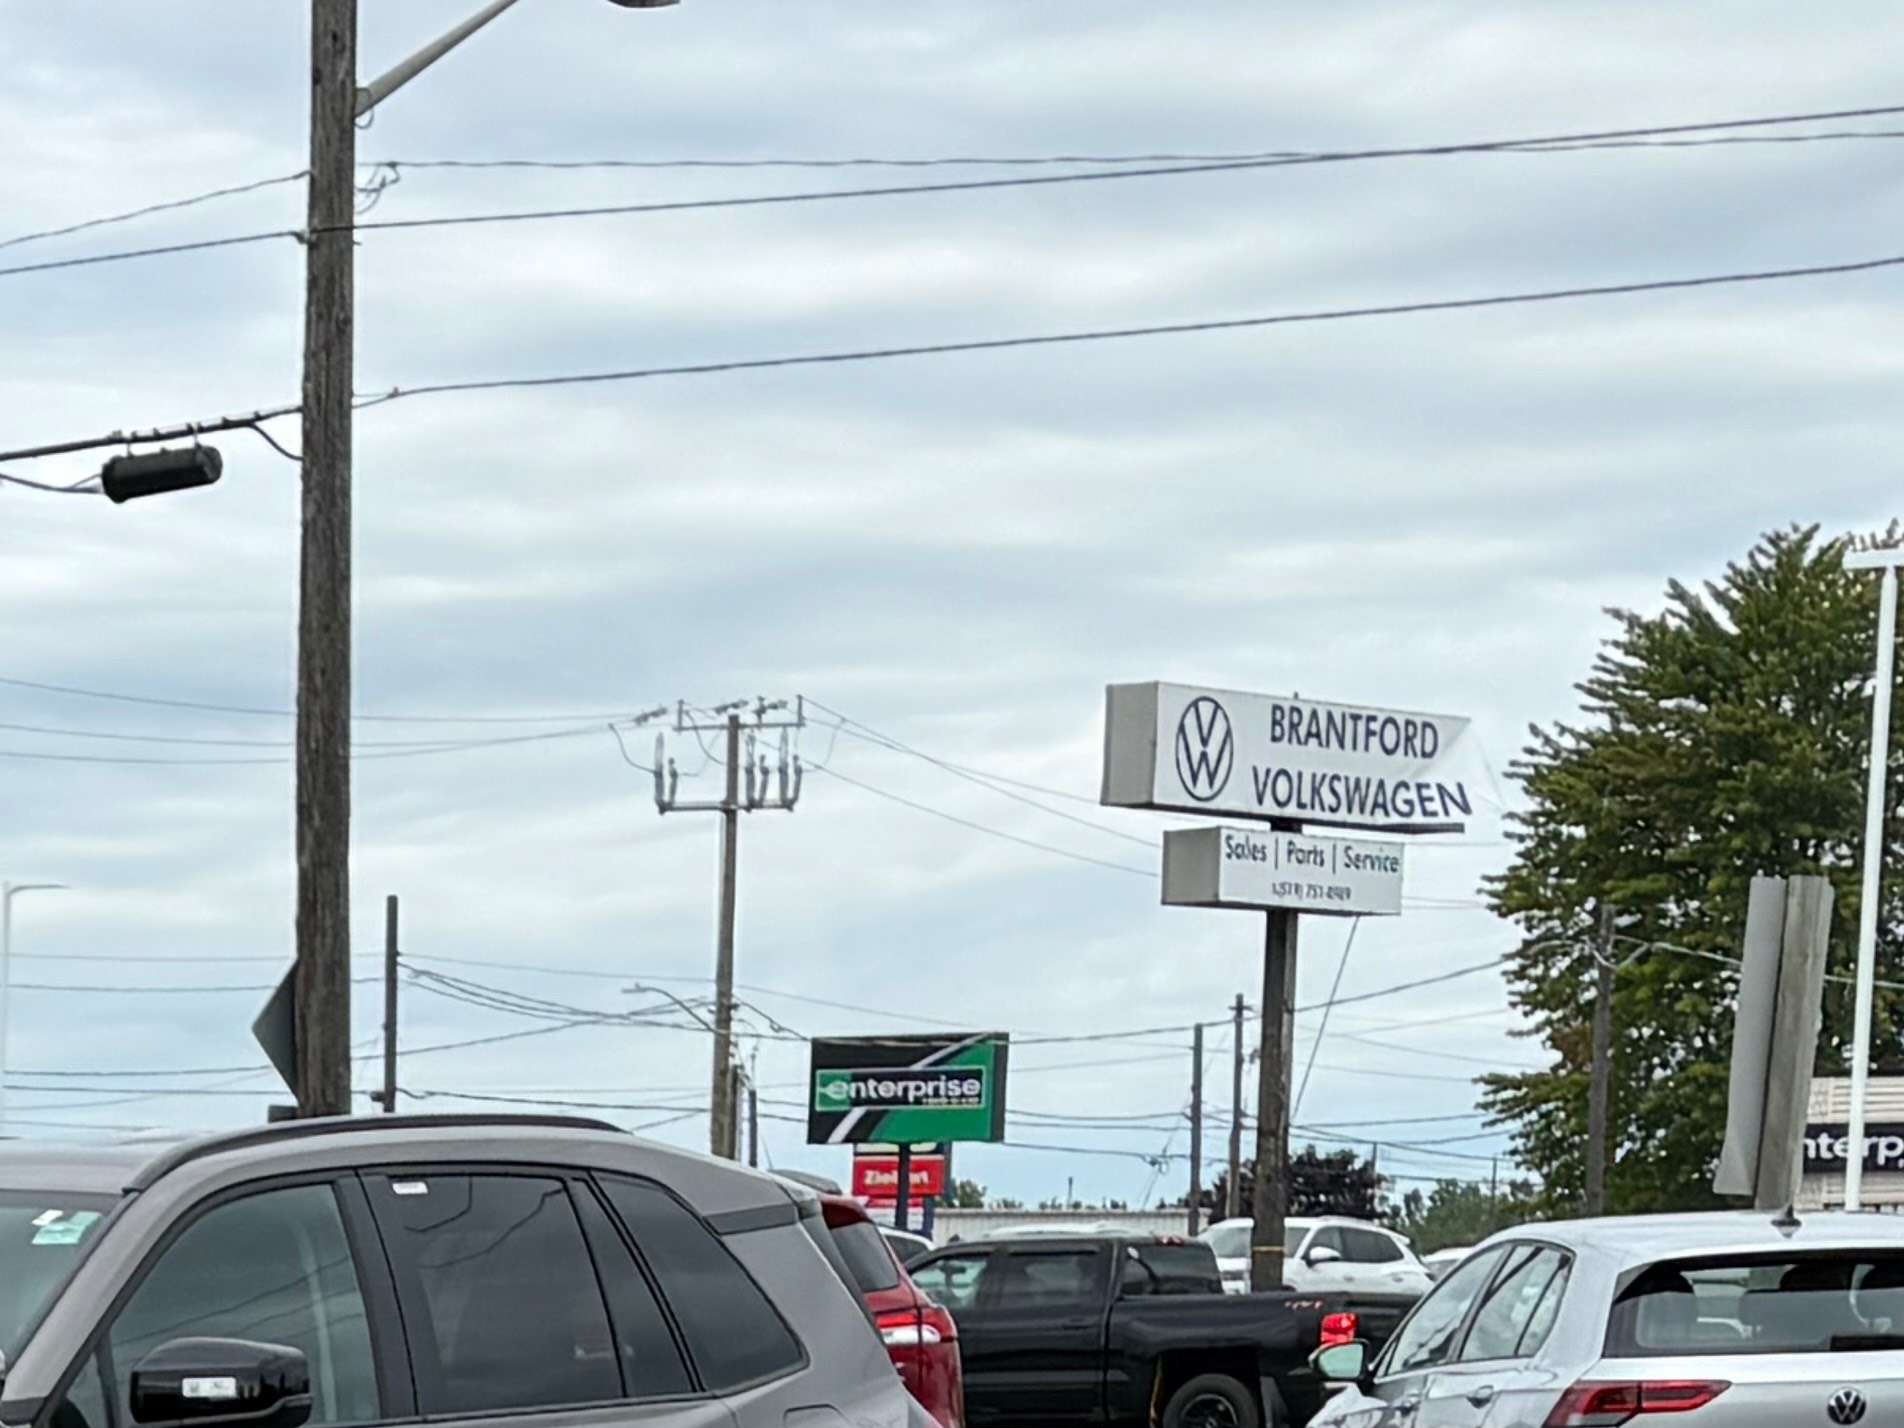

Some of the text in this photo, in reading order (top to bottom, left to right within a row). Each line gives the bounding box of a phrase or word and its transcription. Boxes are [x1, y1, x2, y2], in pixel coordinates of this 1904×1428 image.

[1271, 703, 1439, 760] BRANTFORD
[1252, 765, 1474, 819] VOLKSWAGEN
[1224, 834, 1401, 873] Sales Parts Service
[824, 1074, 982, 1104] enterprise
